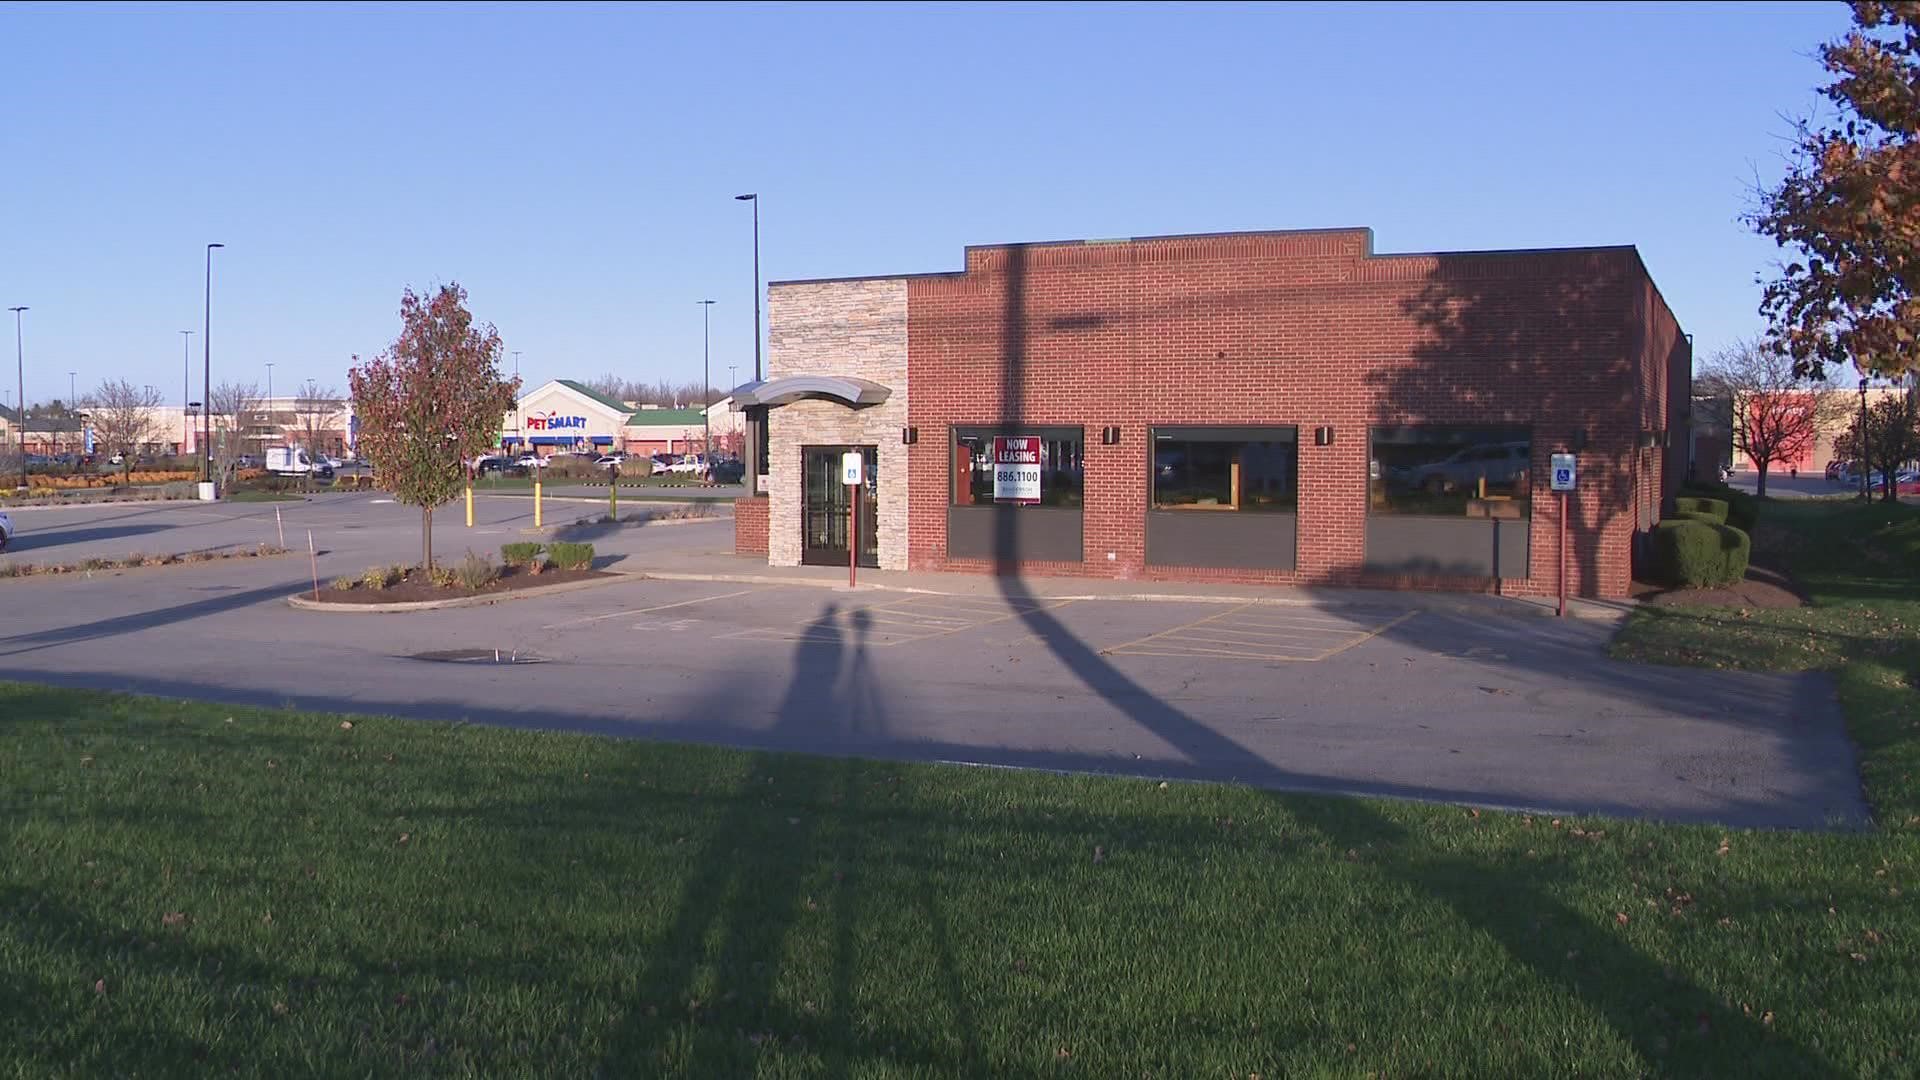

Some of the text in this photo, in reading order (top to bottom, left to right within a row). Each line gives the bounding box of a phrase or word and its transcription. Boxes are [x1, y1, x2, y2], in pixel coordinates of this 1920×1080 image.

[1006, 439, 1028, 449] NOW
[999, 451, 1036, 462] LEASING
[997, 472, 1038, 482] 886.1100
